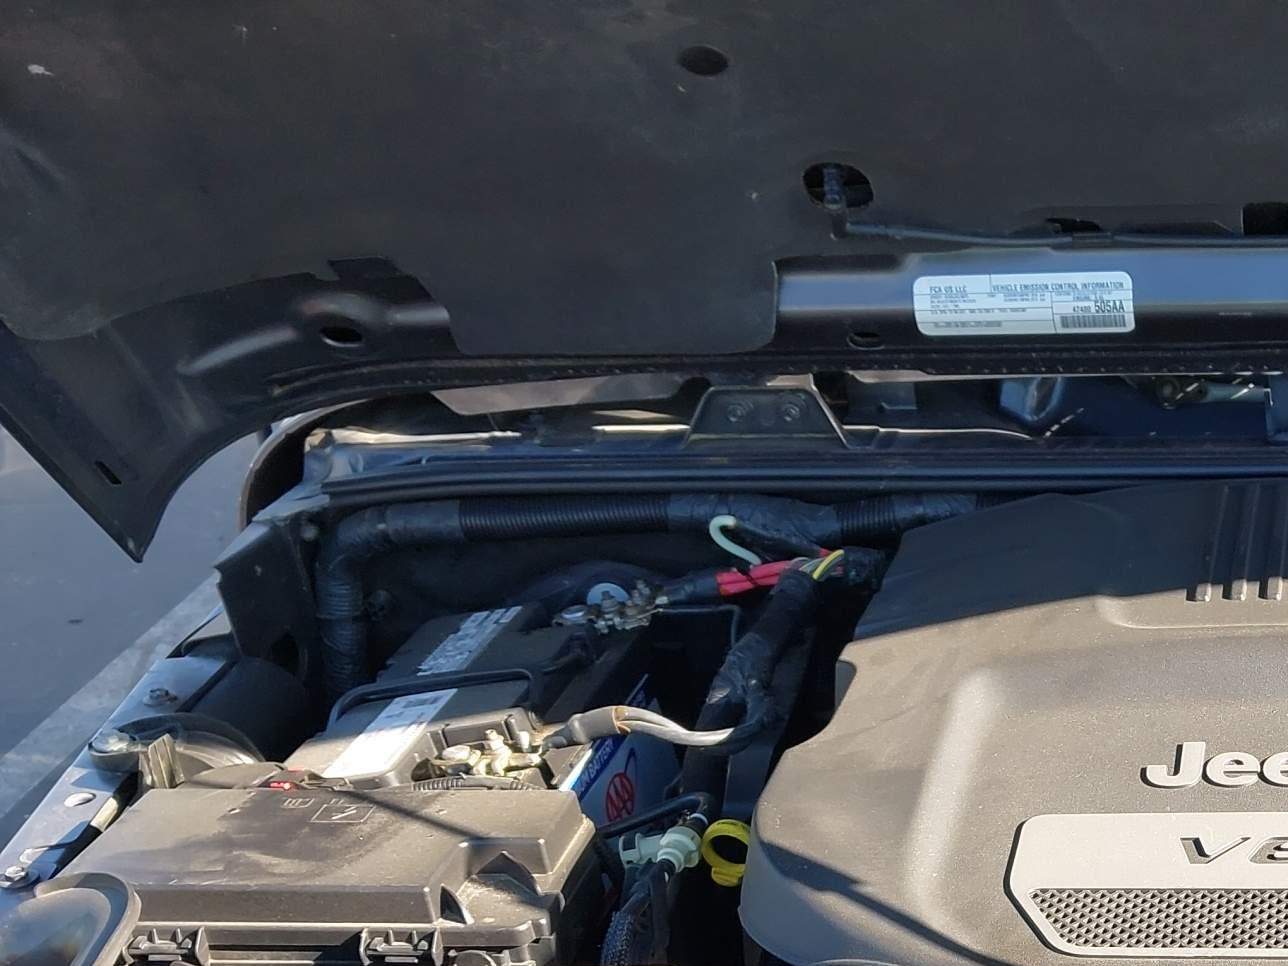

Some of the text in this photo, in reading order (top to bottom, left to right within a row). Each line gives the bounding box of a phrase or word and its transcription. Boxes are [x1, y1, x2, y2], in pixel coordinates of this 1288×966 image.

[992, 281, 1124, 292] VEHICLE EMISSION CONTROL INFORMATION
[1094, 300, 1125, 313] 505AA
